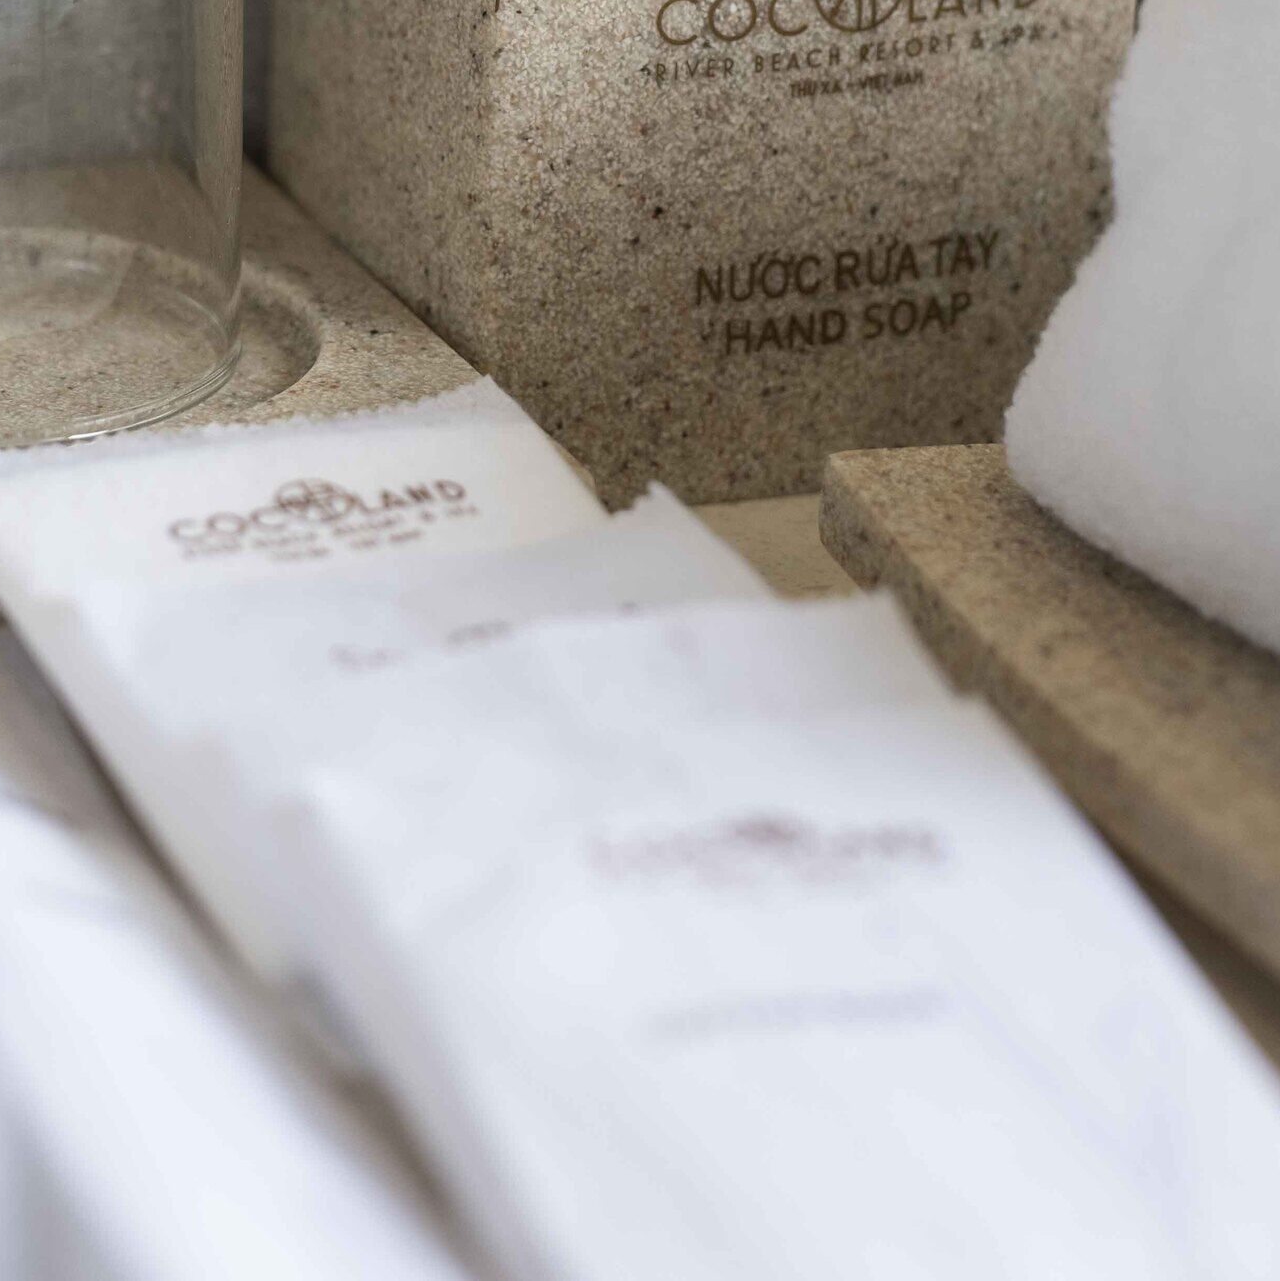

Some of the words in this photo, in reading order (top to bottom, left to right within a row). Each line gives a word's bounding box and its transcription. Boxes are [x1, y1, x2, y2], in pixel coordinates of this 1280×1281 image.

[655, 57, 735, 81] RIVER
[754, 44, 841, 73] BEACH
[859, 32, 956, 62] RESORT
[930, 230, 1000, 278] TAY
[724, 307, 846, 356] HAND
[862, 290, 973, 340] SOAP
